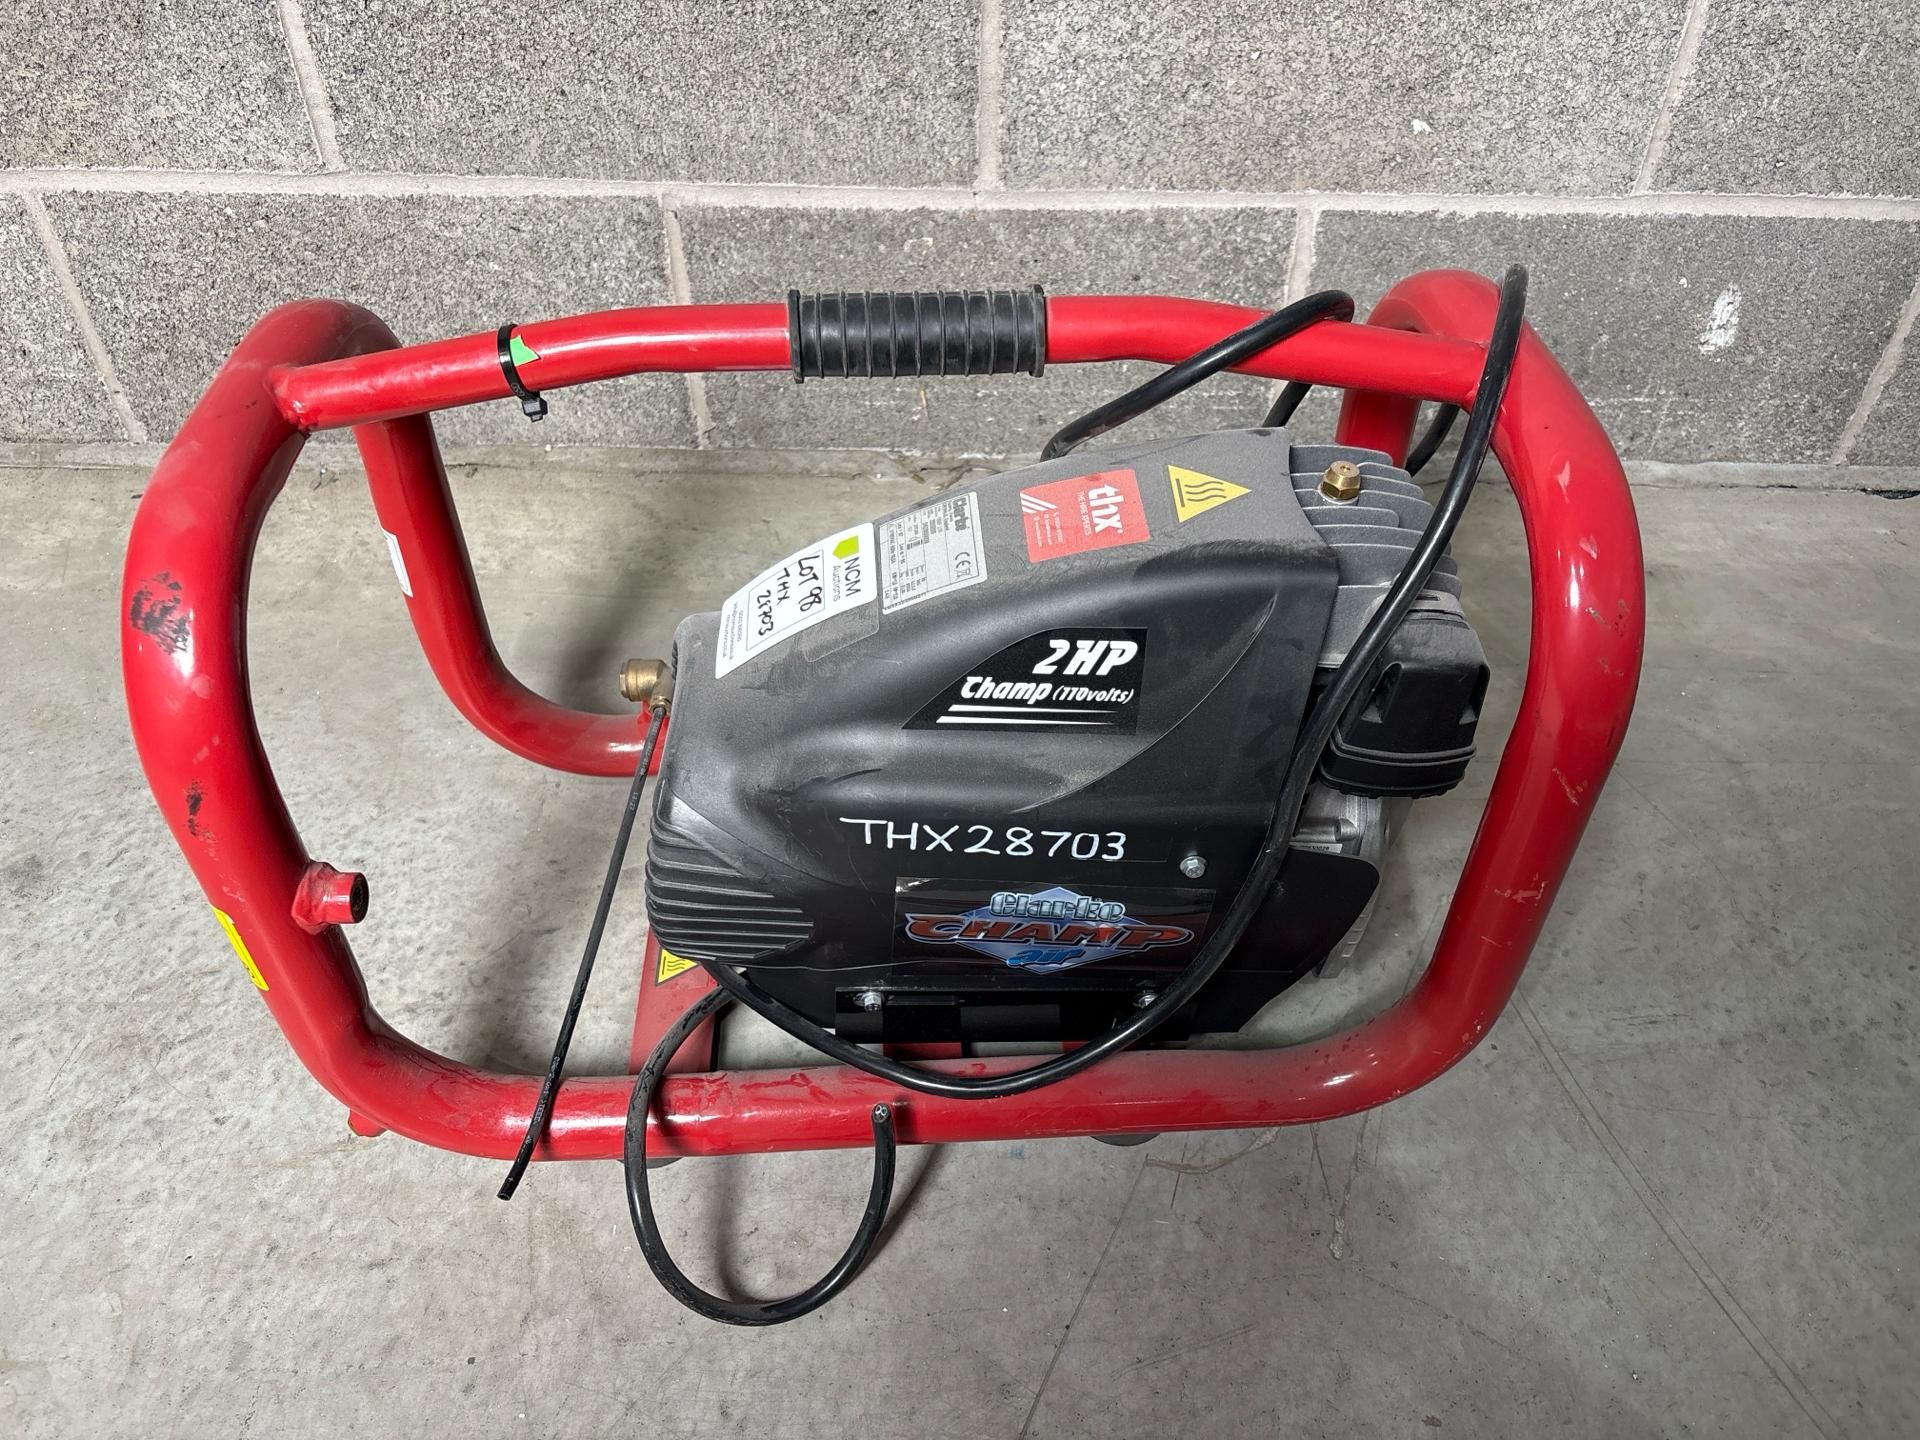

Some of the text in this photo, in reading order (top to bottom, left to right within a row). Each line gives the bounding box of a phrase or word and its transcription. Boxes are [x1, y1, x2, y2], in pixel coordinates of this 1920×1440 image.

[953, 497, 969, 532] Clarke
[1088, 484, 1124, 534] thx
[776, 567, 791, 606] THX
[798, 555, 823, 612] LOT 98
[833, 565, 841, 602] Auctions
[844, 557, 861, 597] NCM
[757, 589, 774, 636] 28703
[960, 676, 1135, 705] Champ (110volts)
[839, 816, 1127, 862] THX28703
[989, 891, 1128, 923] Clarke
[904, 912, 1196, 950] CHAMP
[1007, 945, 1085, 967] air
